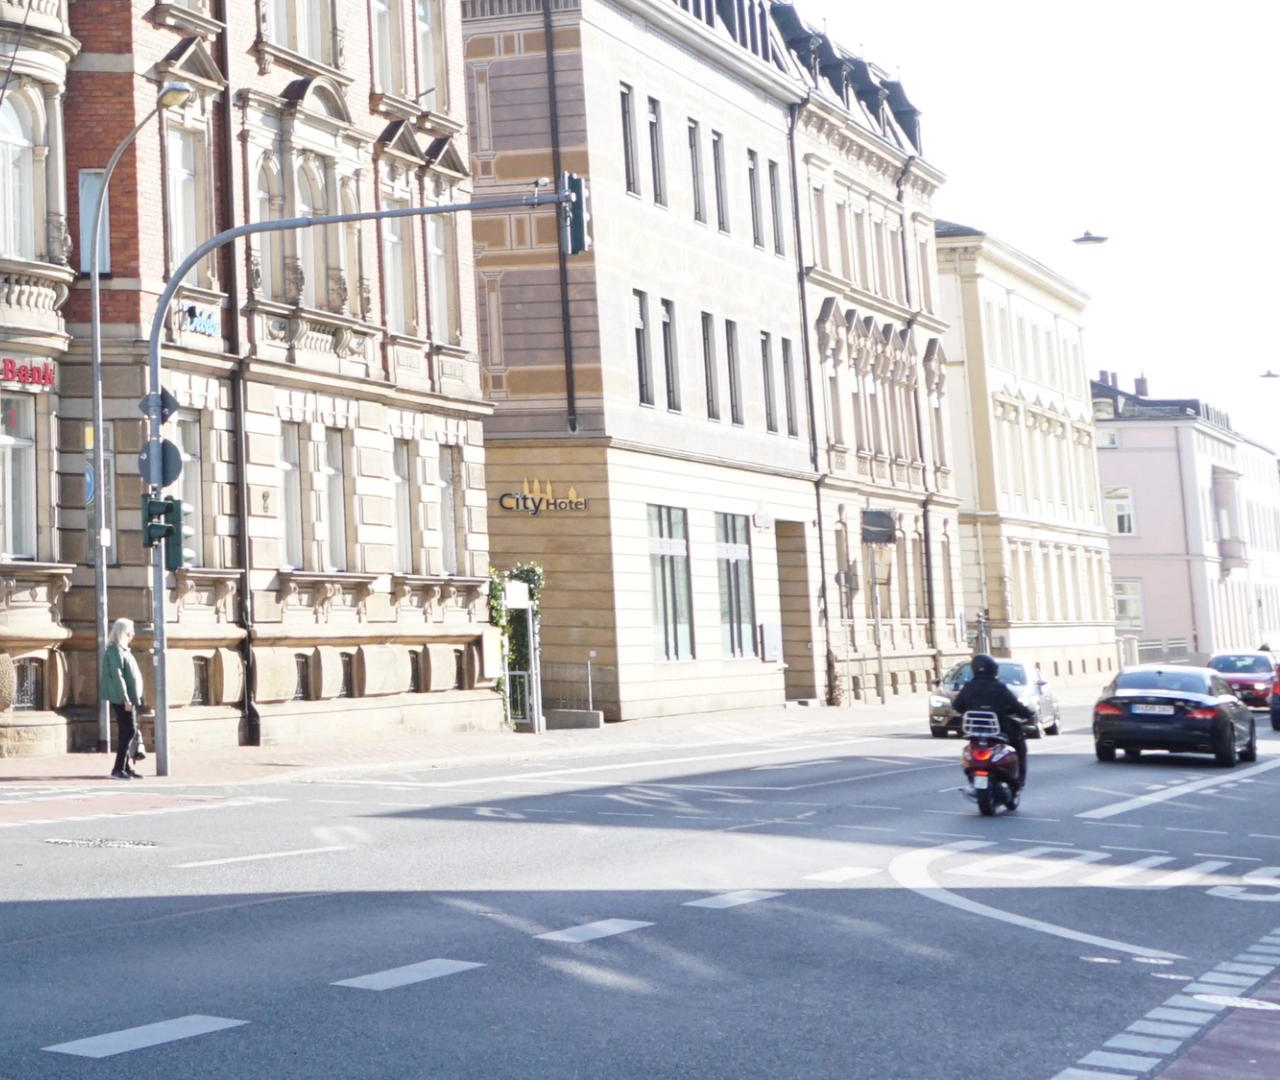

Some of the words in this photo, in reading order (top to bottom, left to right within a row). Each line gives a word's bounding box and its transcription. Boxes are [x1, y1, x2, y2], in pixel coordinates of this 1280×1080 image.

[2, 358, 56, 385] Bank
[498, 492, 543, 516] City
[546, 498, 588, 511] Hotel
